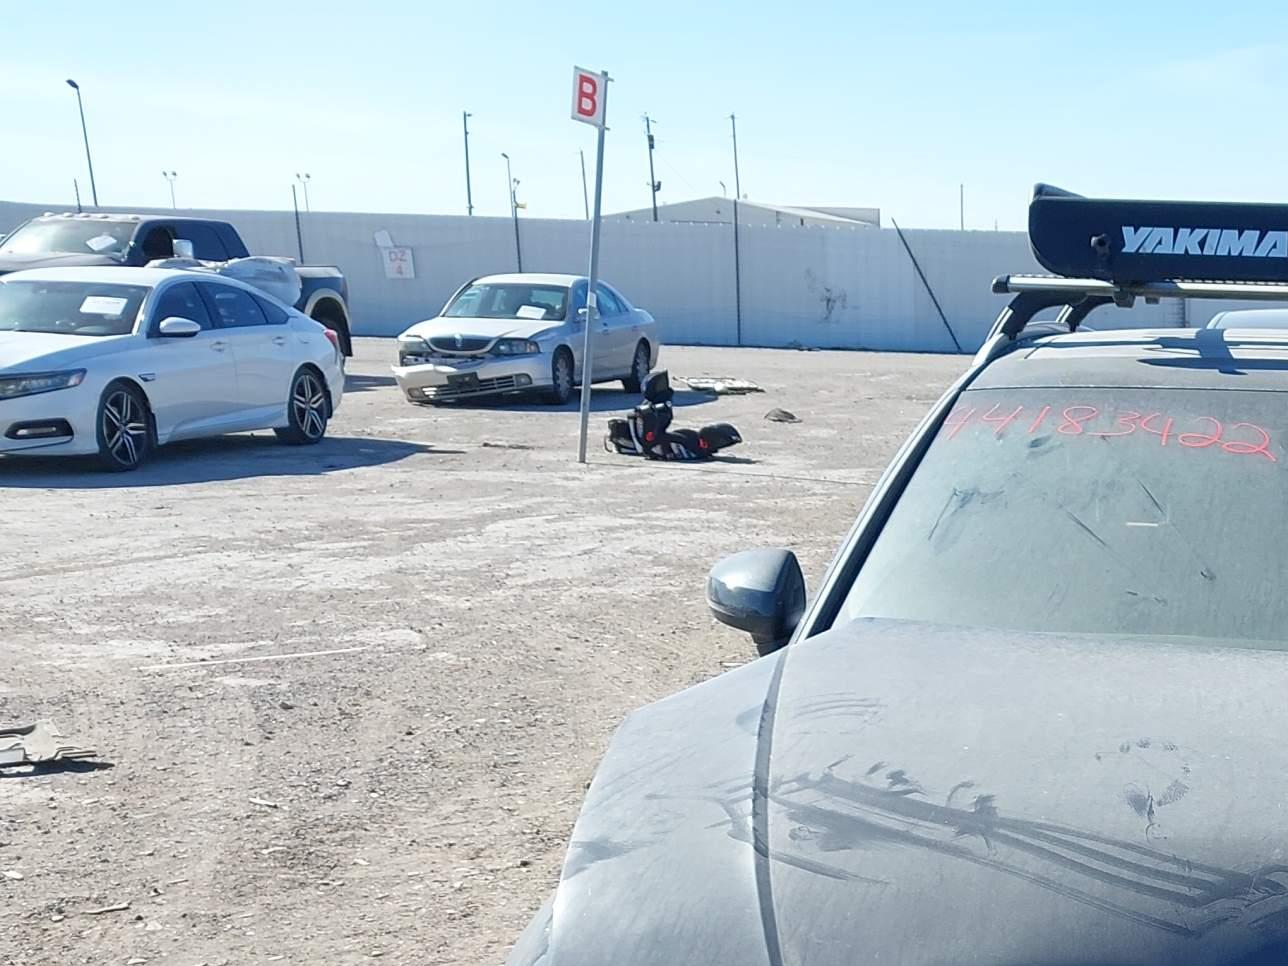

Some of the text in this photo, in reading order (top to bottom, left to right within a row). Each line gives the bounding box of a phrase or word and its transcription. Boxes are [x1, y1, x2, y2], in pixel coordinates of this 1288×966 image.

[578, 74, 597, 117] B
[1121, 226, 1288, 258] YAKIMA
[944, 402, 1277, 463] 44183422
